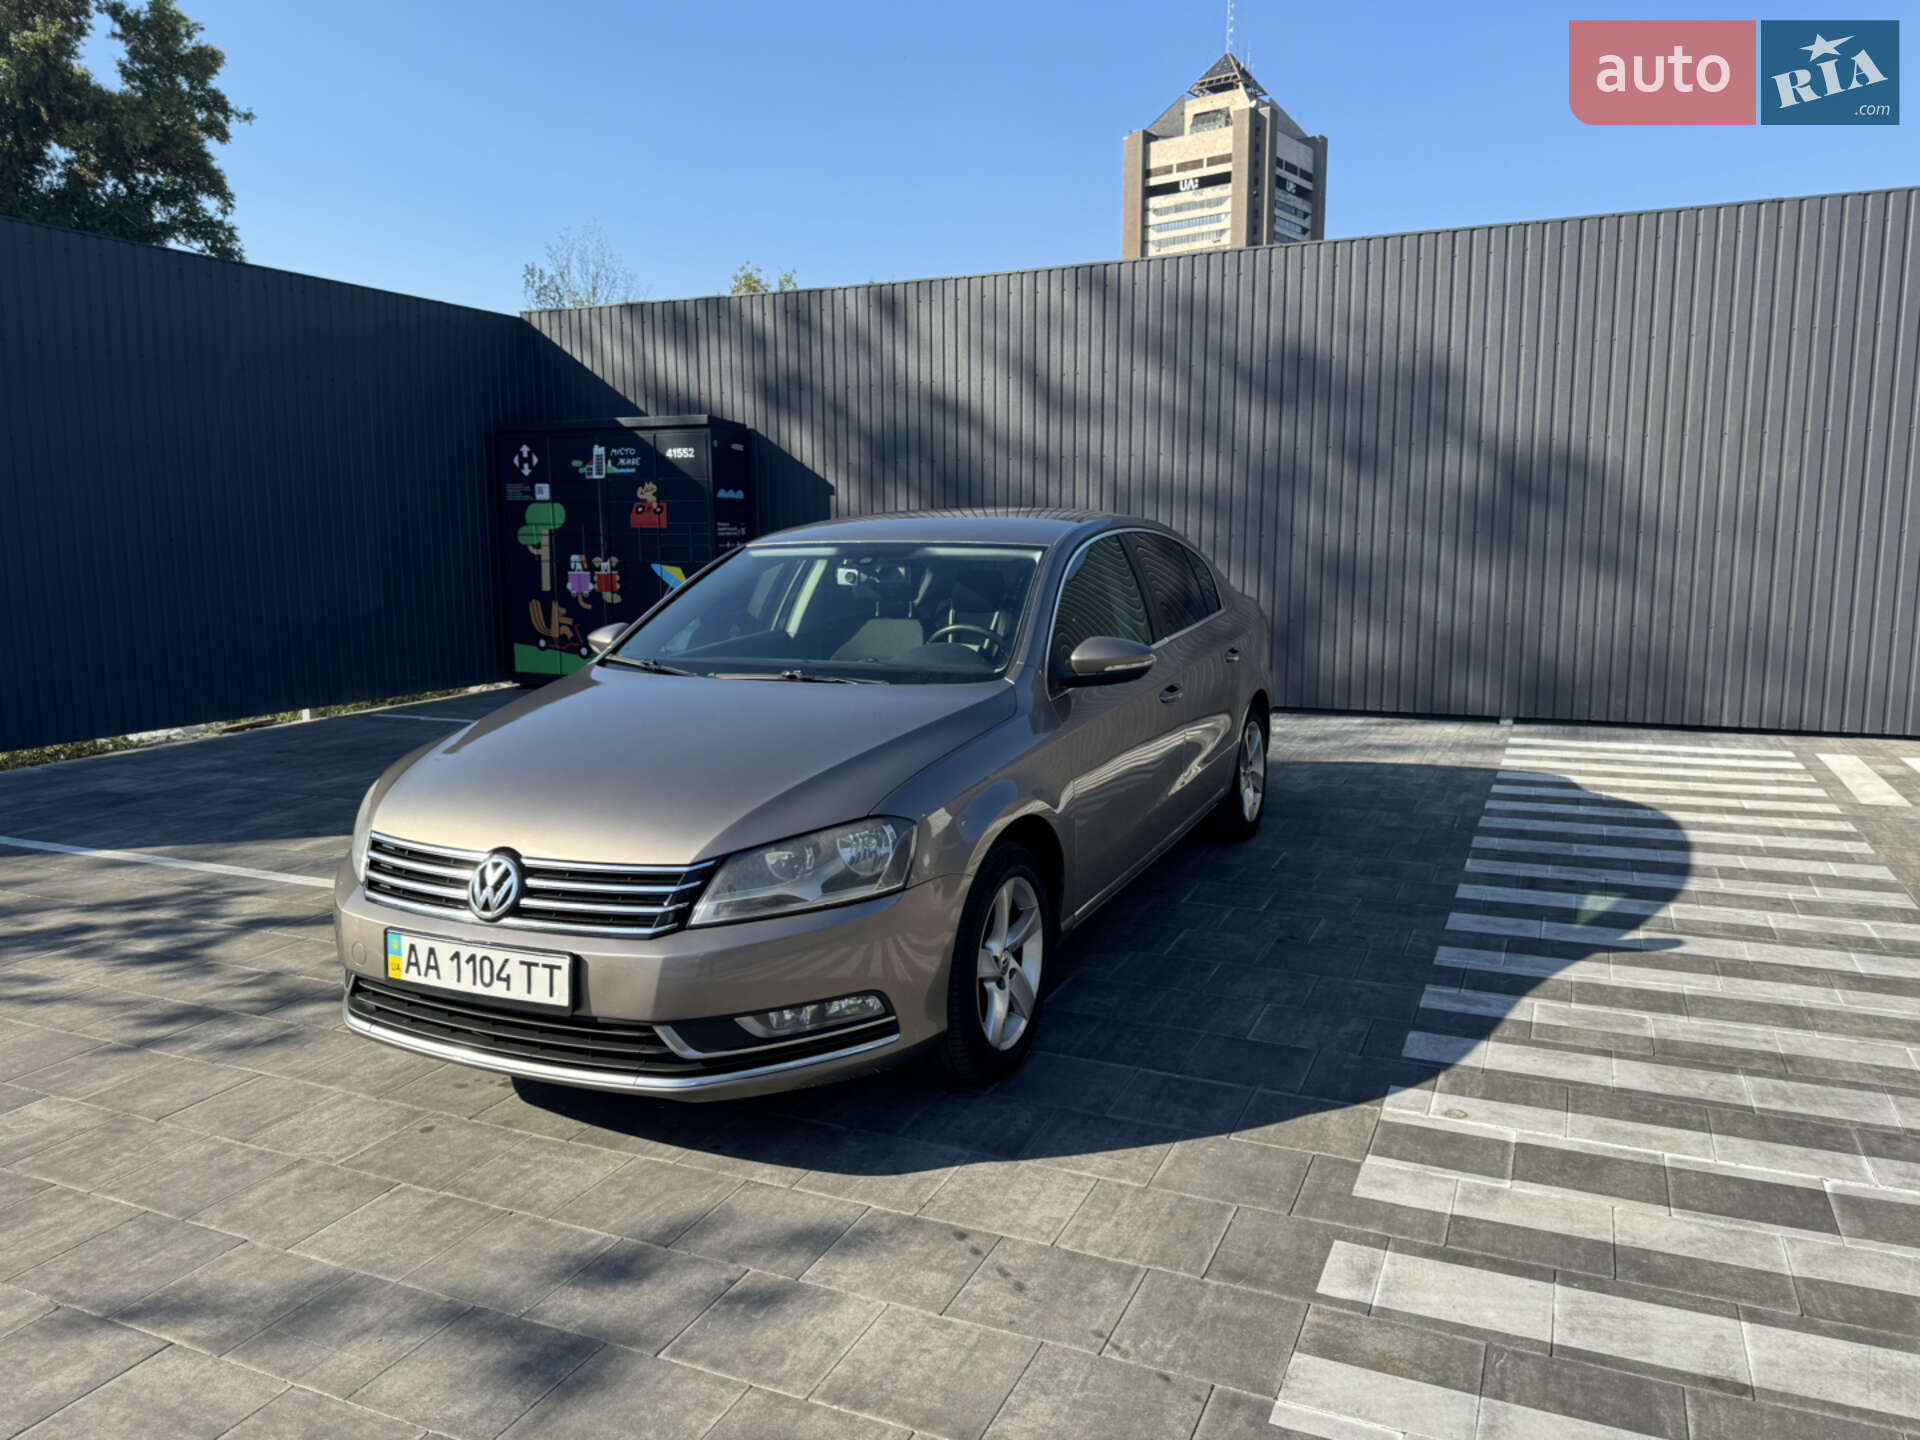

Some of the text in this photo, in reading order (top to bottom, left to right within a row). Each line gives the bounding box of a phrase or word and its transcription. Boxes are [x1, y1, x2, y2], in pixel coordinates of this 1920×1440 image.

[665, 447, 695, 458] 41552
[405, 943, 562, 997] AA 1104 TT
